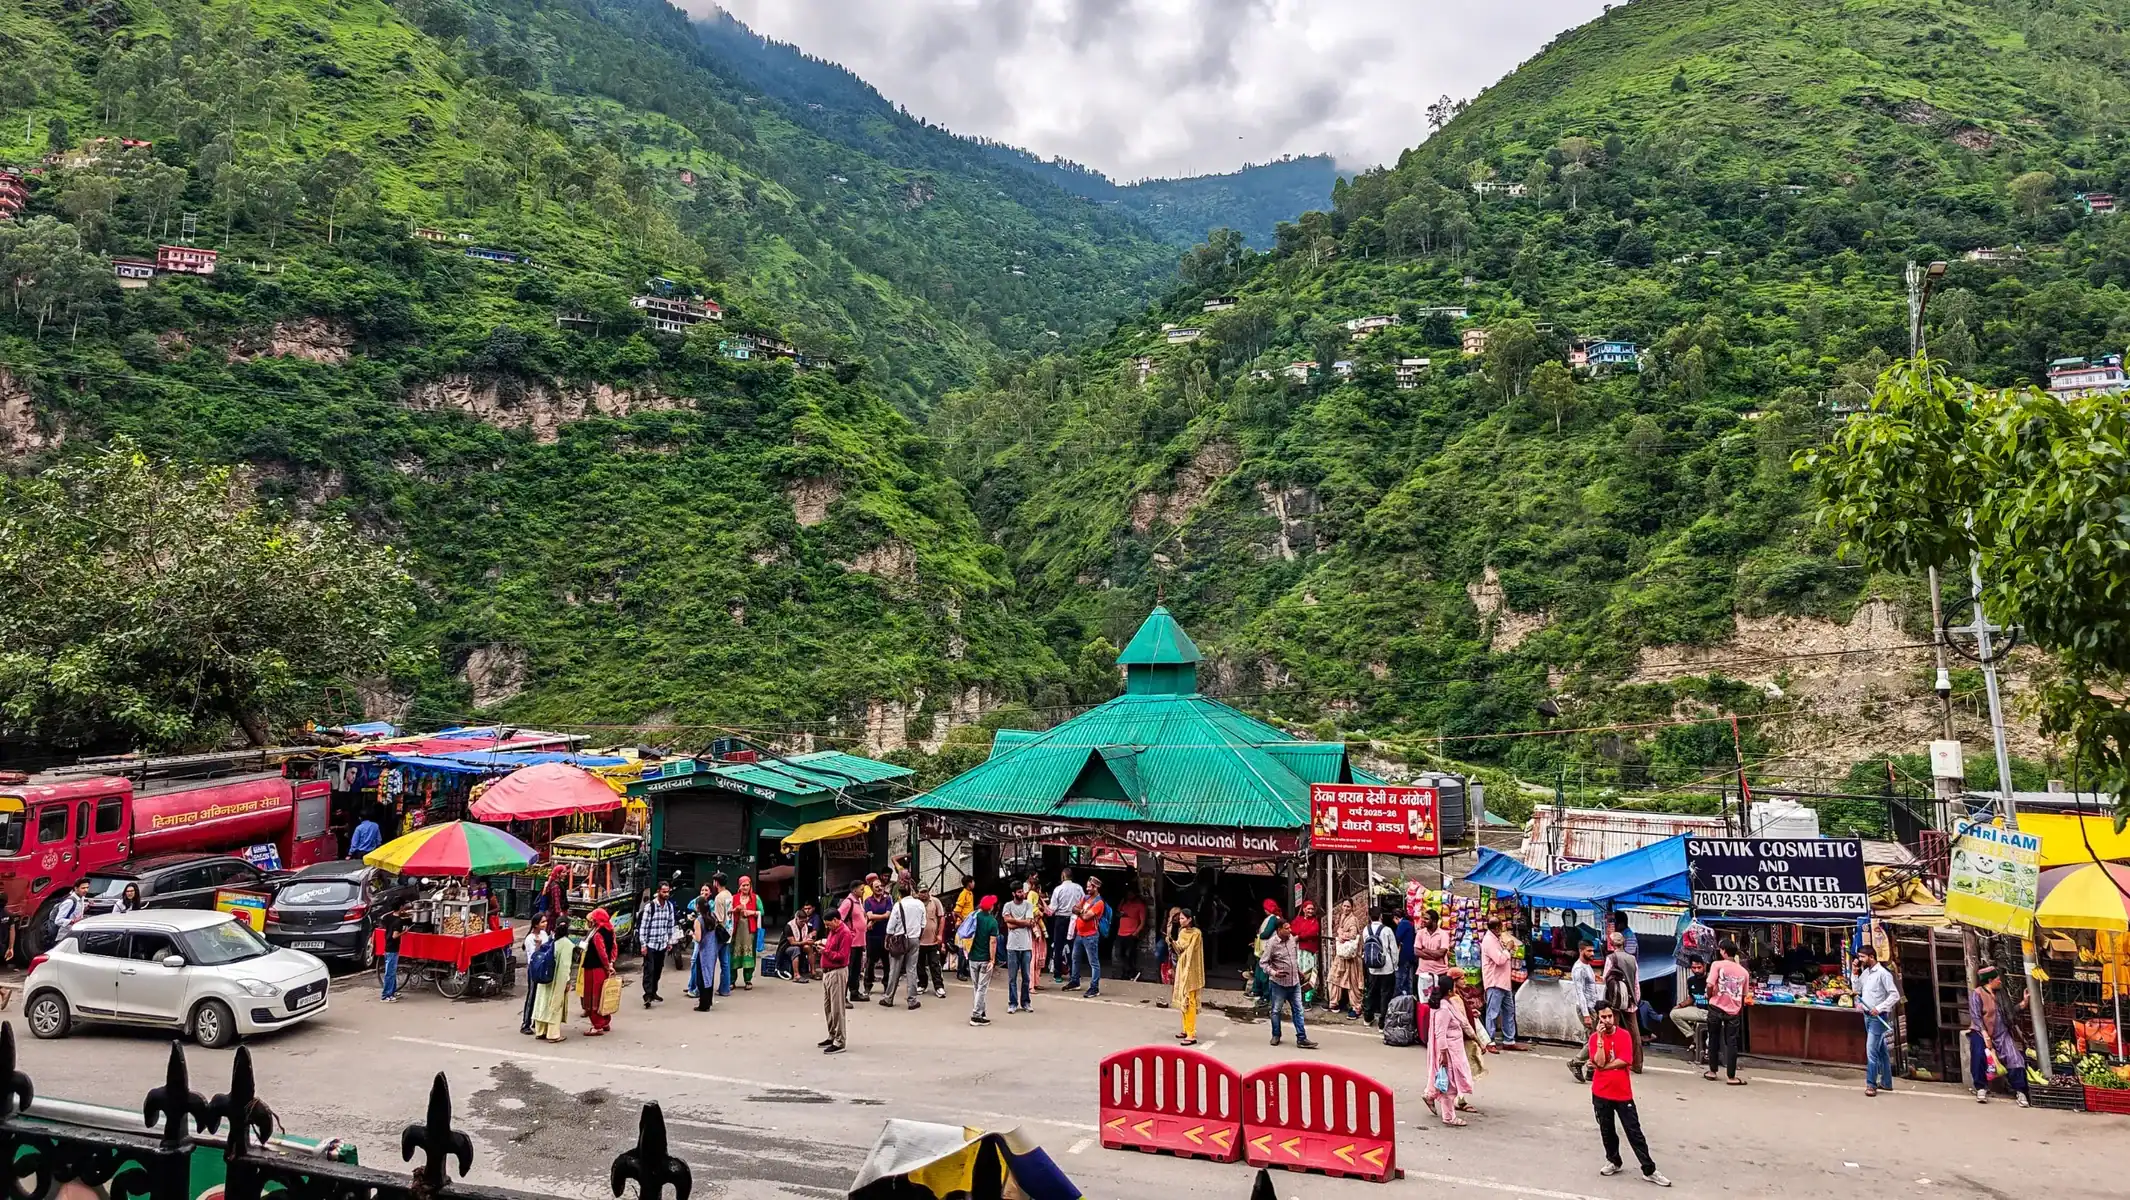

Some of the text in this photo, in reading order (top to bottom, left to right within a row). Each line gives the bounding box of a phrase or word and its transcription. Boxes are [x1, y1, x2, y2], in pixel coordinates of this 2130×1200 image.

[647, 777, 693, 791] यातायात
[1314, 787, 1335, 802] ठेका
[1338, 791, 1363, 803] शराब
[1366, 789, 1387, 805] देसी
[1388, 793, 1397, 805] व
[152, 796, 280, 829] हिमाचल अग्निशमन सेवा
[1349, 806, 1397, 817] वर्ष 2025-26
[1126, 829, 1279, 851] punjab national bank
[1688, 840, 1857, 858] SATVIK COSMETIC
[1758, 860, 1789, 873] AND
[1712, 874, 1840, 892] TOYS CENTER
